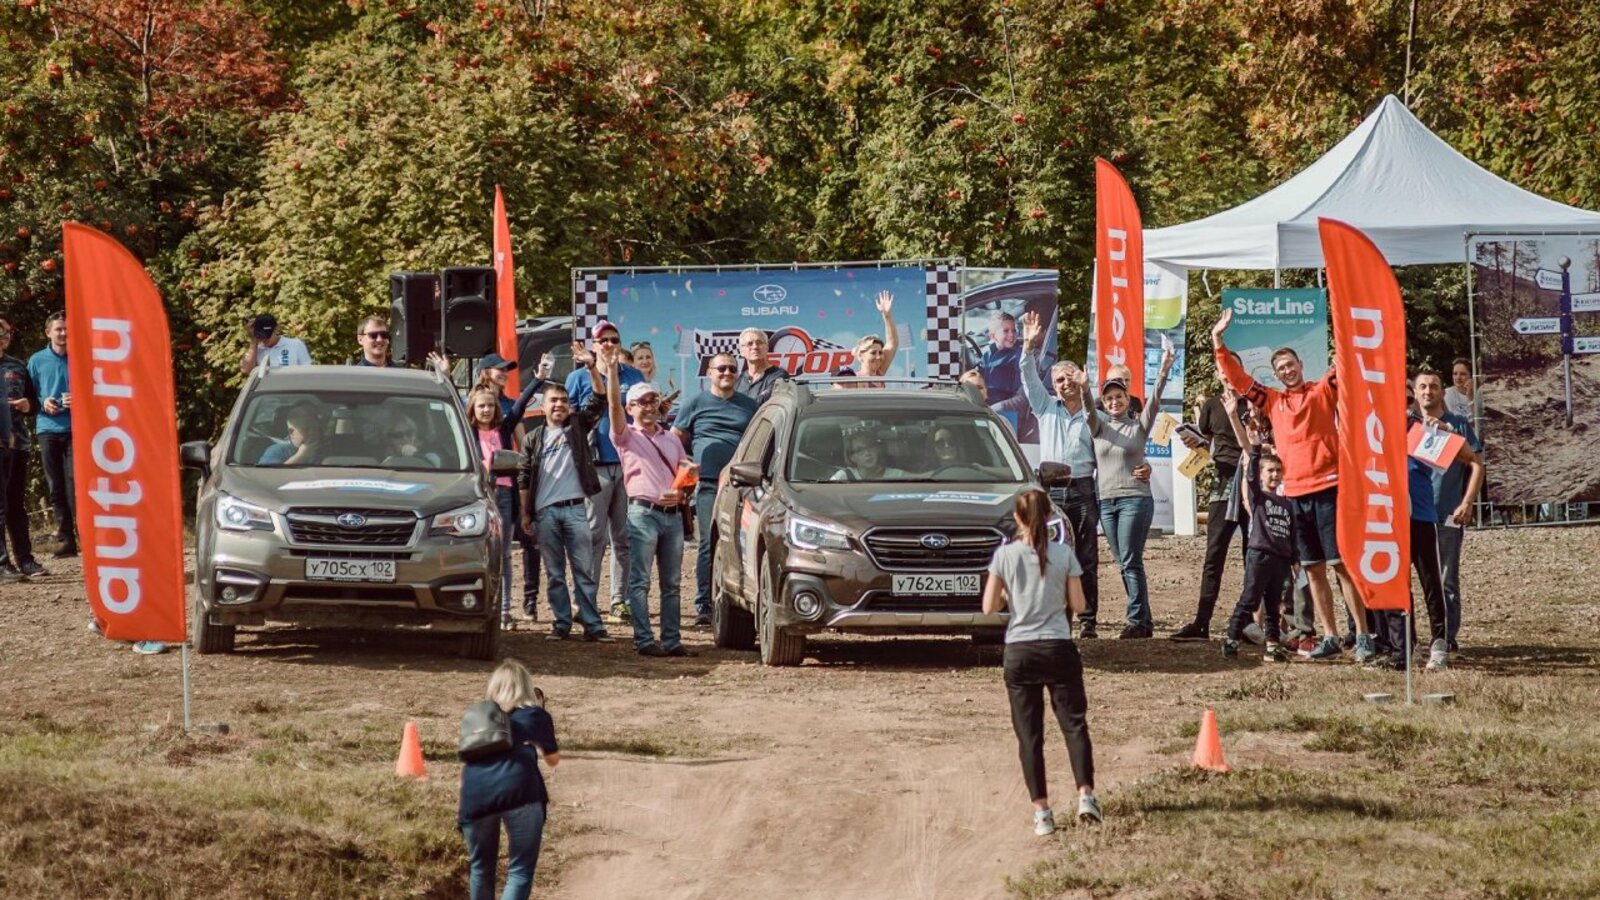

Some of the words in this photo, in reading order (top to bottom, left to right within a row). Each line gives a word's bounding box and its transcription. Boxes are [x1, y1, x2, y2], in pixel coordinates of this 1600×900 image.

[741, 306, 799, 316] SUBARU
[1233, 297, 1315, 315] StarLine
[370, 562, 392, 574] 102
[956, 576, 977, 587] 102
